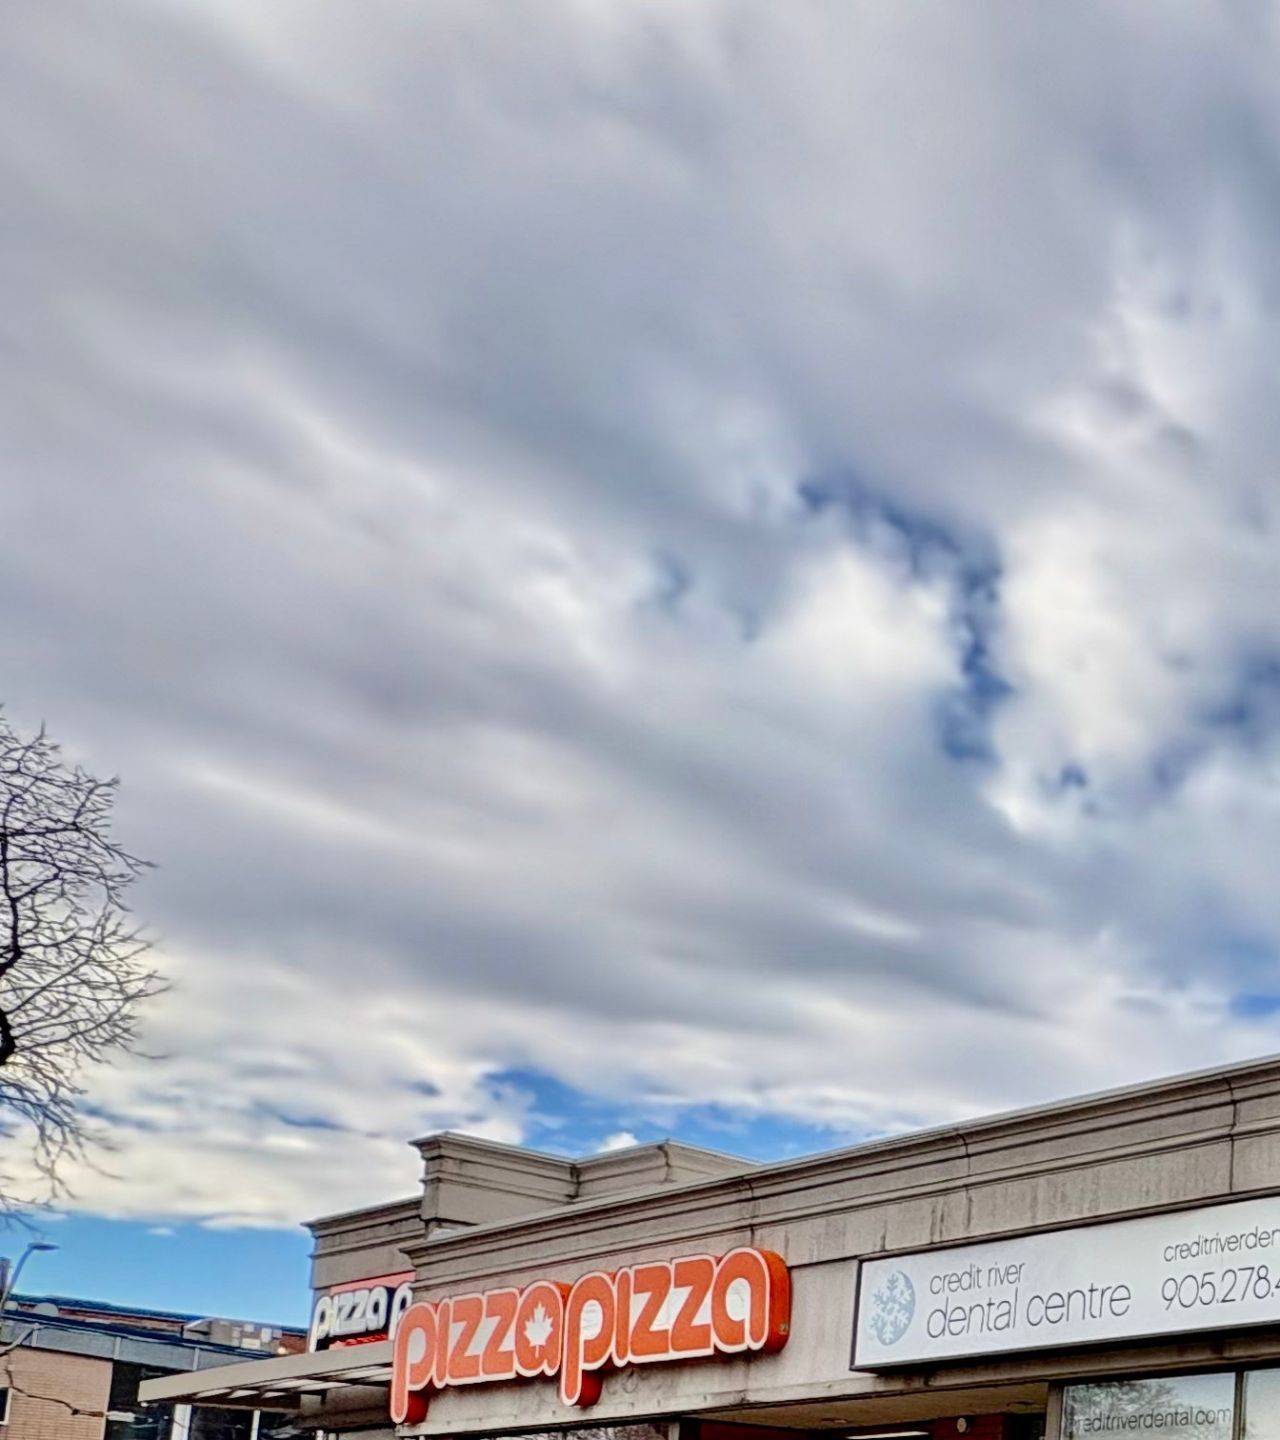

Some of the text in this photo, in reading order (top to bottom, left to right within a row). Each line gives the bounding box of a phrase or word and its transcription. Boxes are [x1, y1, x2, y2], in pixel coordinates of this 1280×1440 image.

[929, 1261, 1026, 1296] credit river
[309, 1286, 388, 1353] pizza
[926, 1282, 1132, 1339] dental centre
[1064, 1407, 1233, 1434] reditriverdental.com
